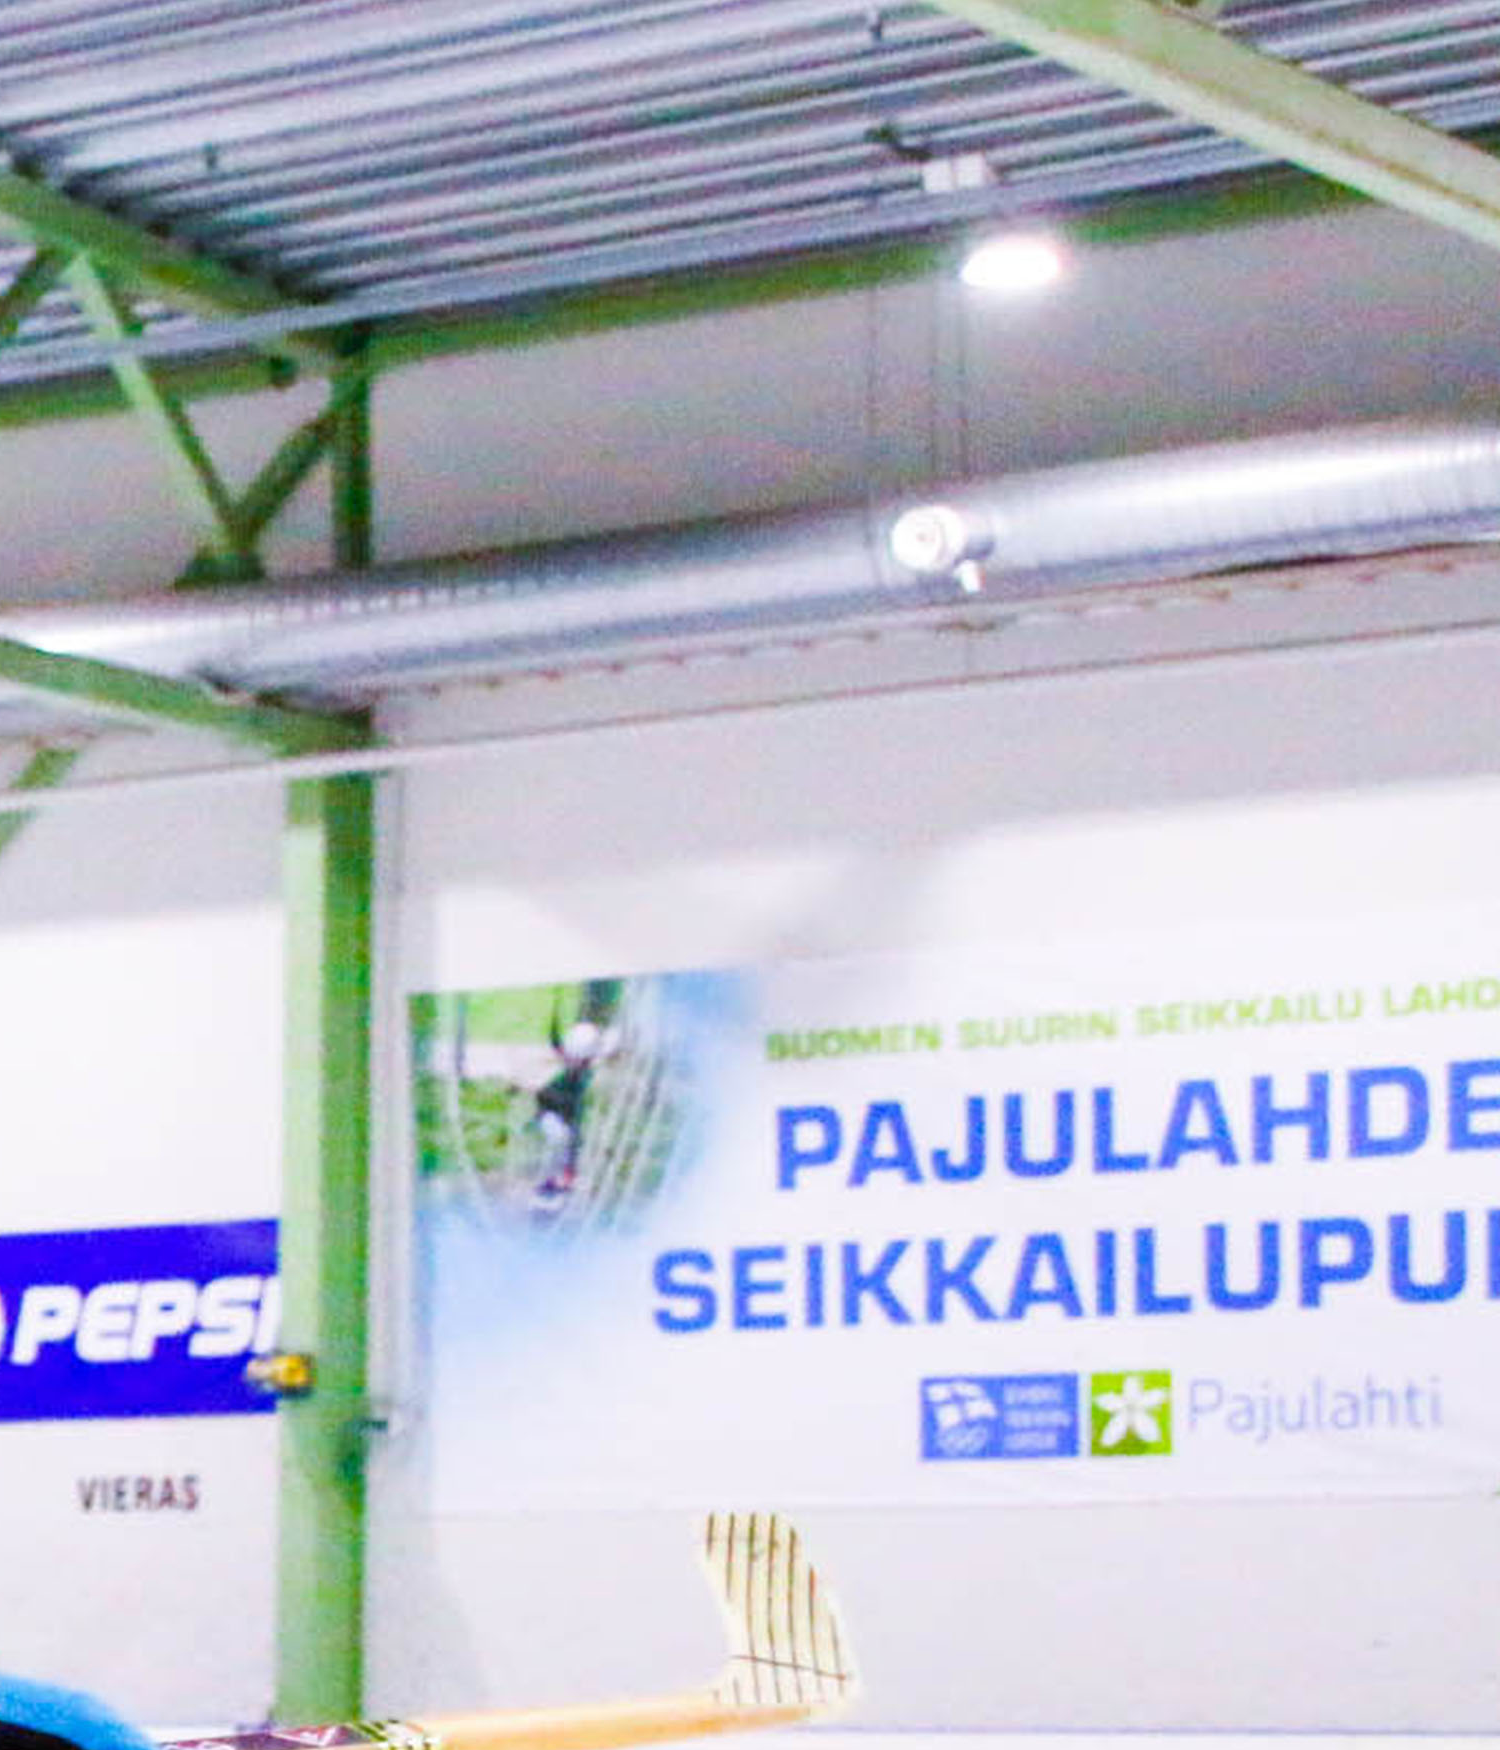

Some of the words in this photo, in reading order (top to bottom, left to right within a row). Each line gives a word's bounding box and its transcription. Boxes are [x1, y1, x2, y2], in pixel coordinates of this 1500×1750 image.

[765, 1022, 942, 1062] SUOMEN
[959, 1010, 1119, 1051] SUURIN
[1136, 989, 1363, 1038] SEIKKAILU
[652, 1208, 1500, 1333] SEIKKAILUPU
[1187, 1374, 1444, 1444] Pajulahti
[76, 1473, 200, 1513] VIERAS
